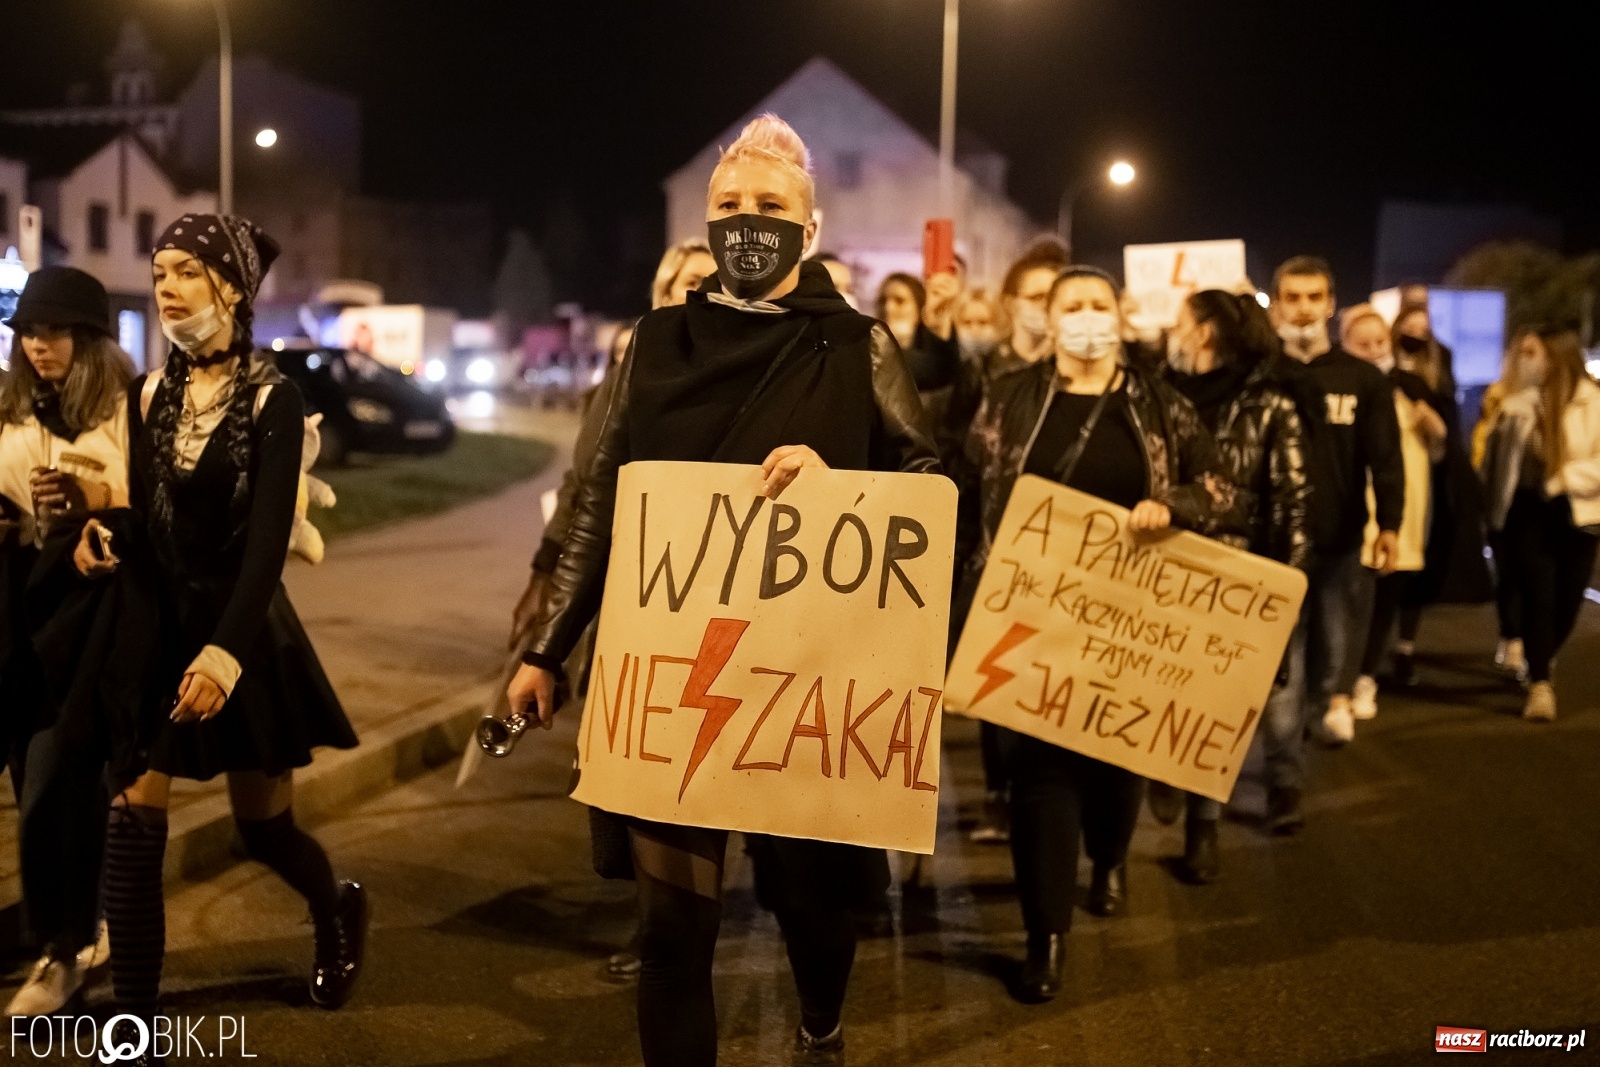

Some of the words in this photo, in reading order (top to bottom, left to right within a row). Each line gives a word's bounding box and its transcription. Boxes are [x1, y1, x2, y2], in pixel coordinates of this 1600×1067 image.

[639, 492, 929, 613] WYBÓR
[1011, 496, 1054, 557] A
[586, 652, 698, 764] NIE
[732, 667, 943, 793] ZAKAZ
[1015, 662, 1075, 729] JA
[1082, 680, 1151, 748] TEŻ
[1147, 700, 1257, 775] NIE!
